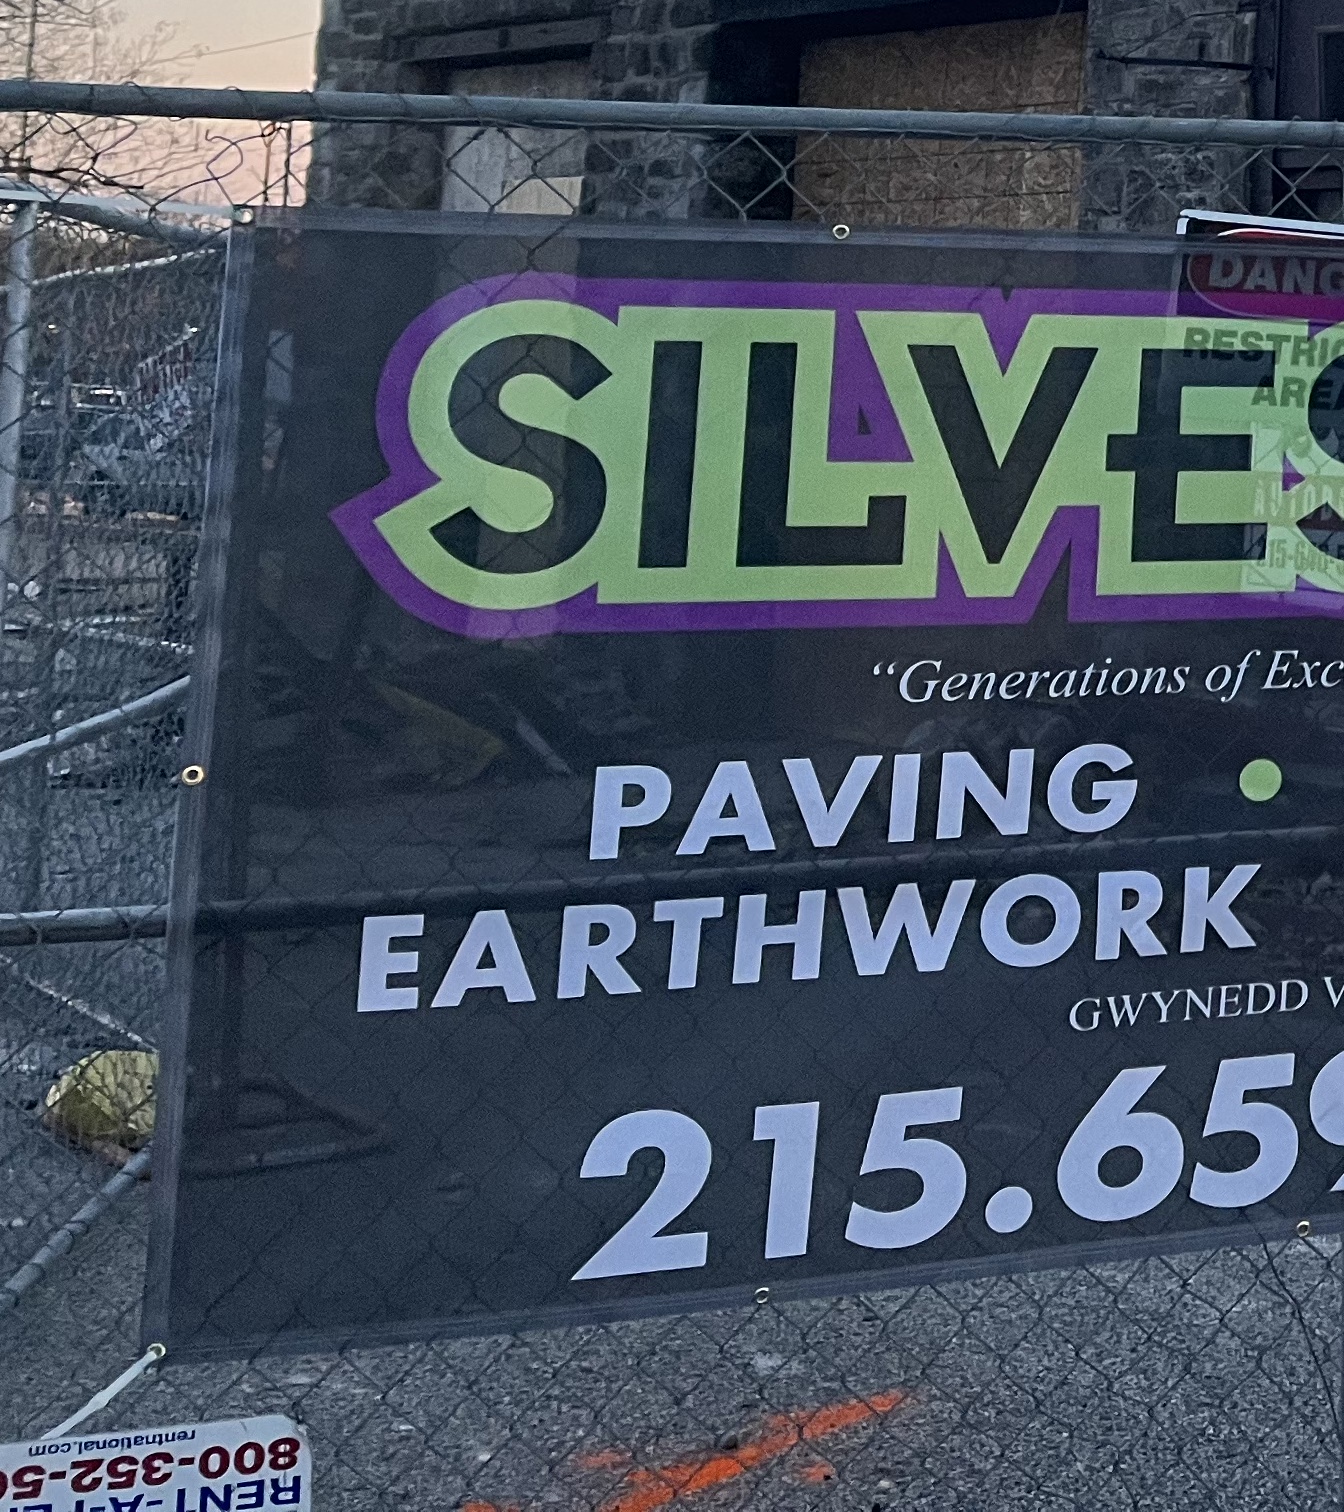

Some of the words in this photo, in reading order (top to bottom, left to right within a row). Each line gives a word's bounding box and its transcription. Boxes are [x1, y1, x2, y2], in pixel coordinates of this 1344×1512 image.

[1205, 649, 1262, 704] of
[588, 743, 1139, 861] PAVING
[356, 863, 1262, 1013] EARTHWORK
[1068, 979, 1310, 1032] GWYNEDD
[0, 1436, 301, 1502] 800-352-5
[28, 1428, 197, 1458] rentnational.com
